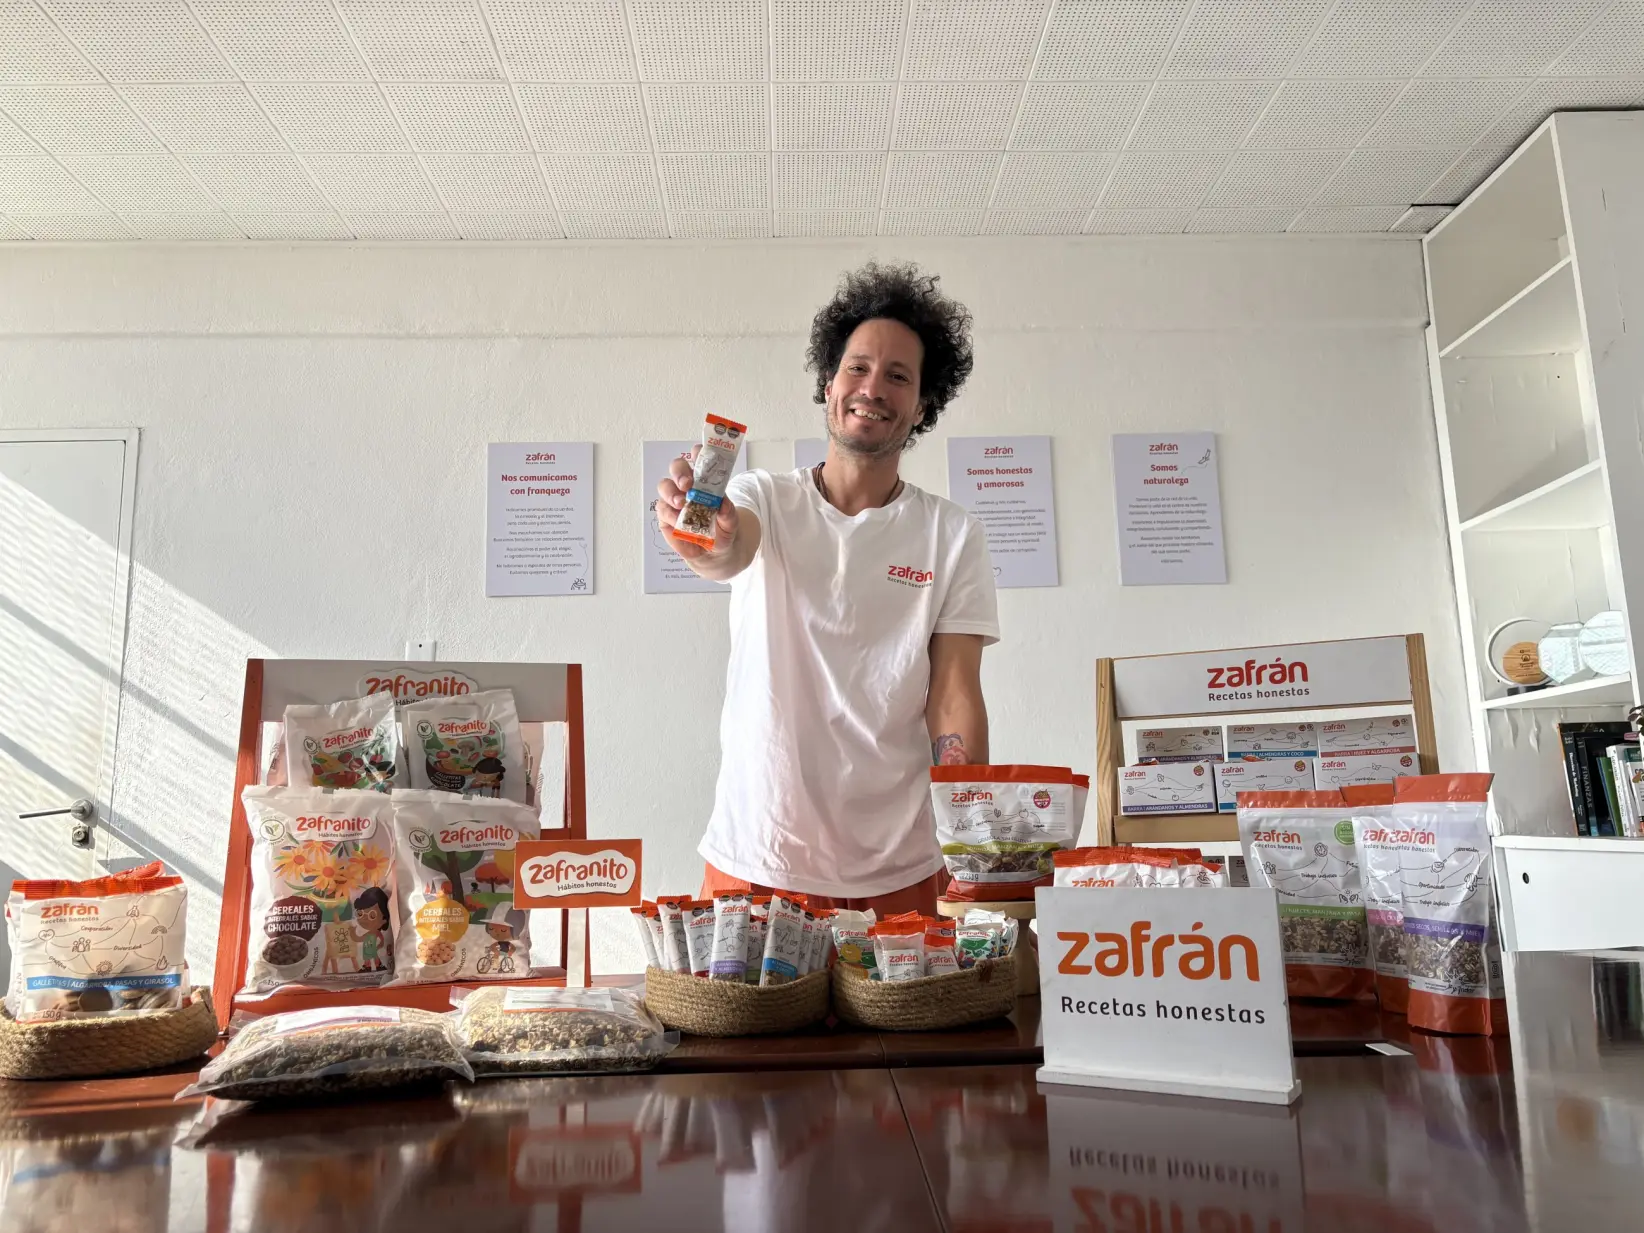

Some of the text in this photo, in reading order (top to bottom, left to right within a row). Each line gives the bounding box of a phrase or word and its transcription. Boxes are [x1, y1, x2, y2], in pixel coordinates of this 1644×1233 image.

[708, 437, 736, 450] zafrán
[1150, 443, 1178, 452] zafrán
[984, 446, 1014, 454] zafrán
[526, 452, 556, 461] zafrán
[519, 473, 578, 482] comunicamos
[1144, 476, 1189, 486] naturaleza
[528, 486, 570, 496] franqueza
[977, 482, 982, 490] y
[888, 565, 933, 582] zafrán
[1207, 657, 1308, 688] zafrán
[1208, 687, 1310, 701] Recetas honestas
[439, 720, 486, 733] zafranito
[1581, 766, 1593, 808] FINANZAS
[951, 790, 993, 802] zafrán
[296, 816, 370, 831] zafranito
[440, 825, 513, 843] zafranito
[1253, 830, 1301, 844] zafrán
[528, 858, 628, 884] zafranito
[558, 882, 584, 891] Hábitos
[1072, 877, 1114, 887] zafrán
[41, 903, 99, 918] zafrán
[273, 905, 314, 915] CEREALES
[424, 908, 462, 916] CEREALES
[722, 905, 748, 914] zafrán
[268, 922, 317, 932] CHOCOLATE
[1056, 921, 1260, 982] zafrán
[928, 956, 954, 965] zafrán
[1062, 996, 1265, 1024] Recetas honestas
